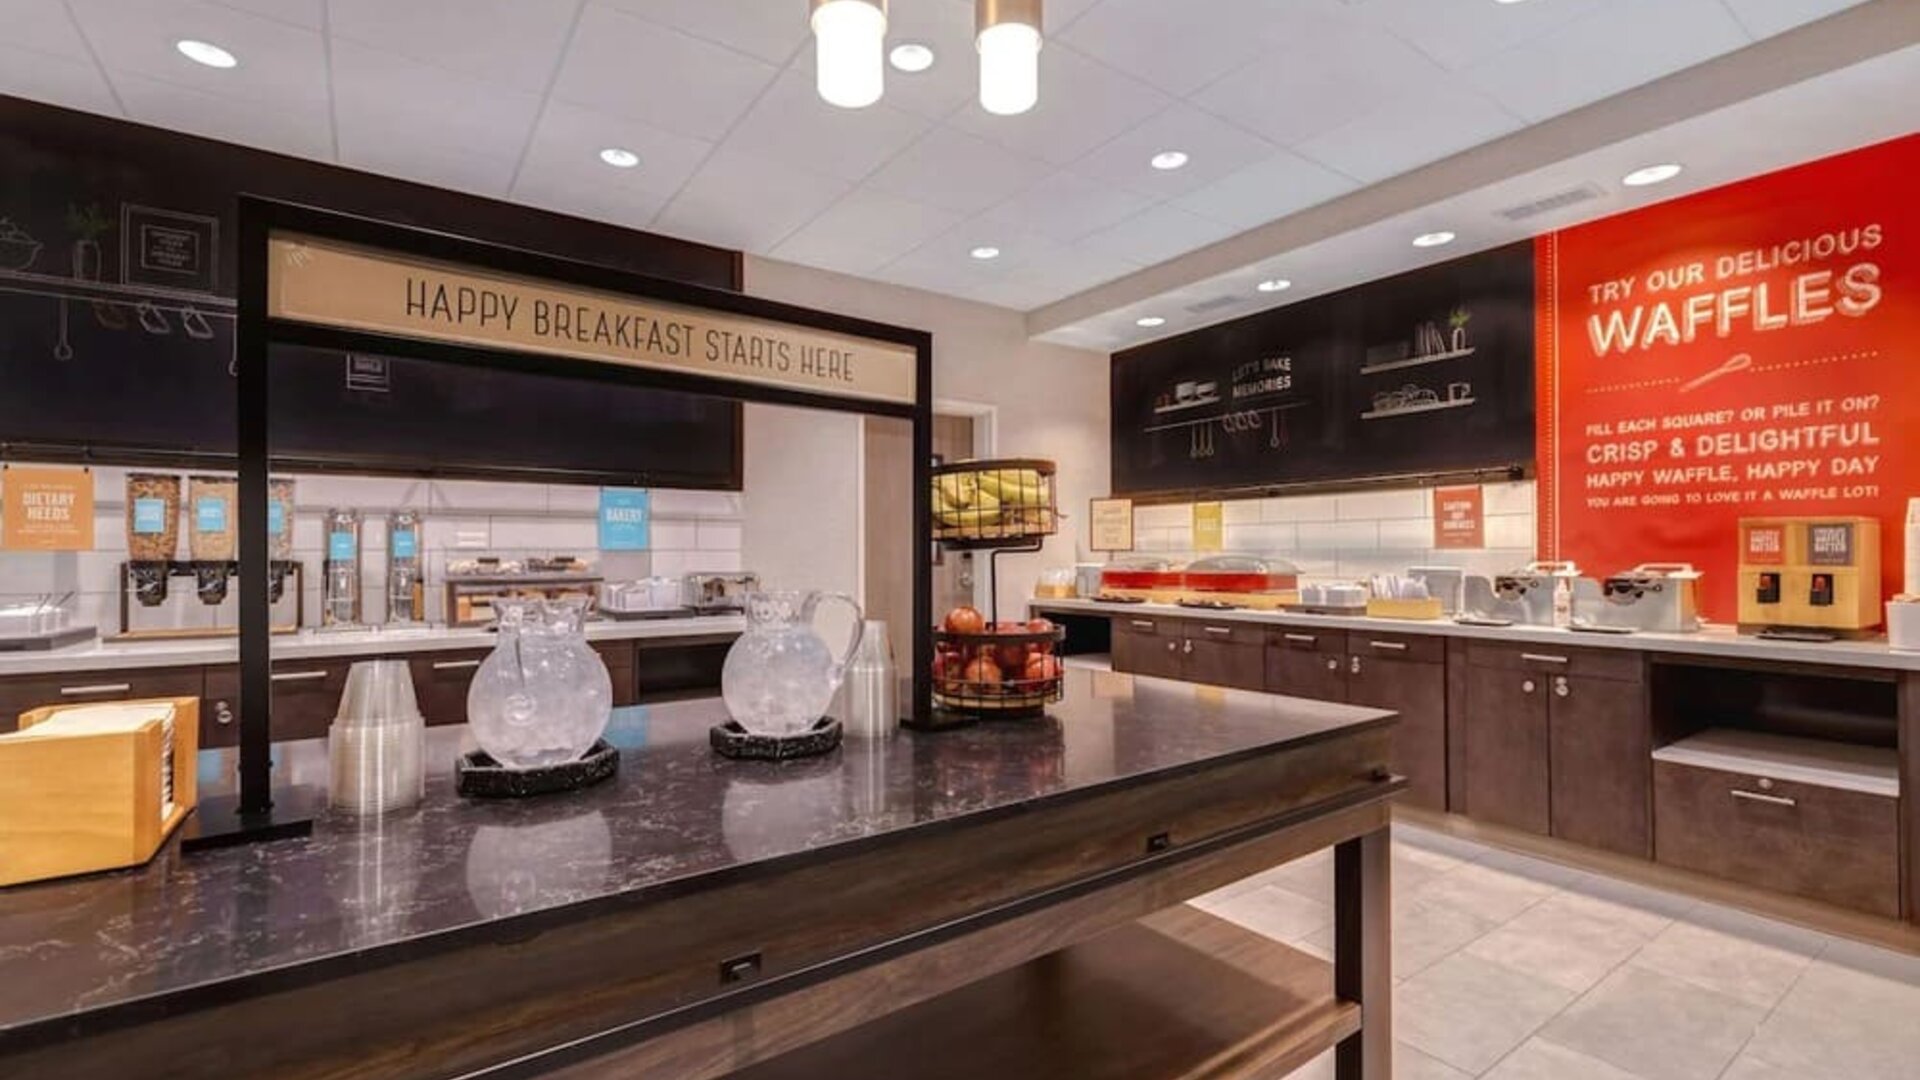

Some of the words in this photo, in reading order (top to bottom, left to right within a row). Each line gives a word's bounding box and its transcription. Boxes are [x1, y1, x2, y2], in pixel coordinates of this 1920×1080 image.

[1589, 276, 1636, 304] TRY
[1646, 262, 1705, 292] OUR
[1716, 223, 1883, 279] DELICIOUS
[1587, 262, 1882, 357] WAFFLES
[406, 278, 519, 331] HAPPY
[534, 299, 696, 358] BREAKFAST
[705, 329, 790, 373] STARTS
[801, 345, 855, 382] HERE
[1232, 375, 1291, 398] MEMORIES
[1586, 423, 1613, 437] FILL
[1617, 417, 1657, 434] EACH
[1662, 409, 1735, 430] SQUARE?
[1741, 406, 1766, 421] OR
[1772, 401, 1810, 420] PILE
[1815, 399, 1834, 415] IT
[1841, 394, 1880, 412] ON?
[1586, 439, 1658, 464] CRISP
[1669, 436, 1685, 458] &
[1696, 421, 1880, 457] DELIGHTFUL
[1586, 470, 1644, 488] HAPPY
[1746, 459, 1821, 481] HAPPY
[1830, 456, 1880, 476] DAY
[22, 491, 76, 506] DIETARY
[1613, 495, 1637, 506] ARE
[1685, 493, 1702, 504] TO
[1706, 490, 1740, 503] LOVE
[1743, 490, 1758, 502] IT
[1763, 489, 1773, 501] A
[1779, 487, 1838, 500] WAFFLE
[27, 506, 70, 520] NEEDS
[606, 508, 643, 523] BAKERY
